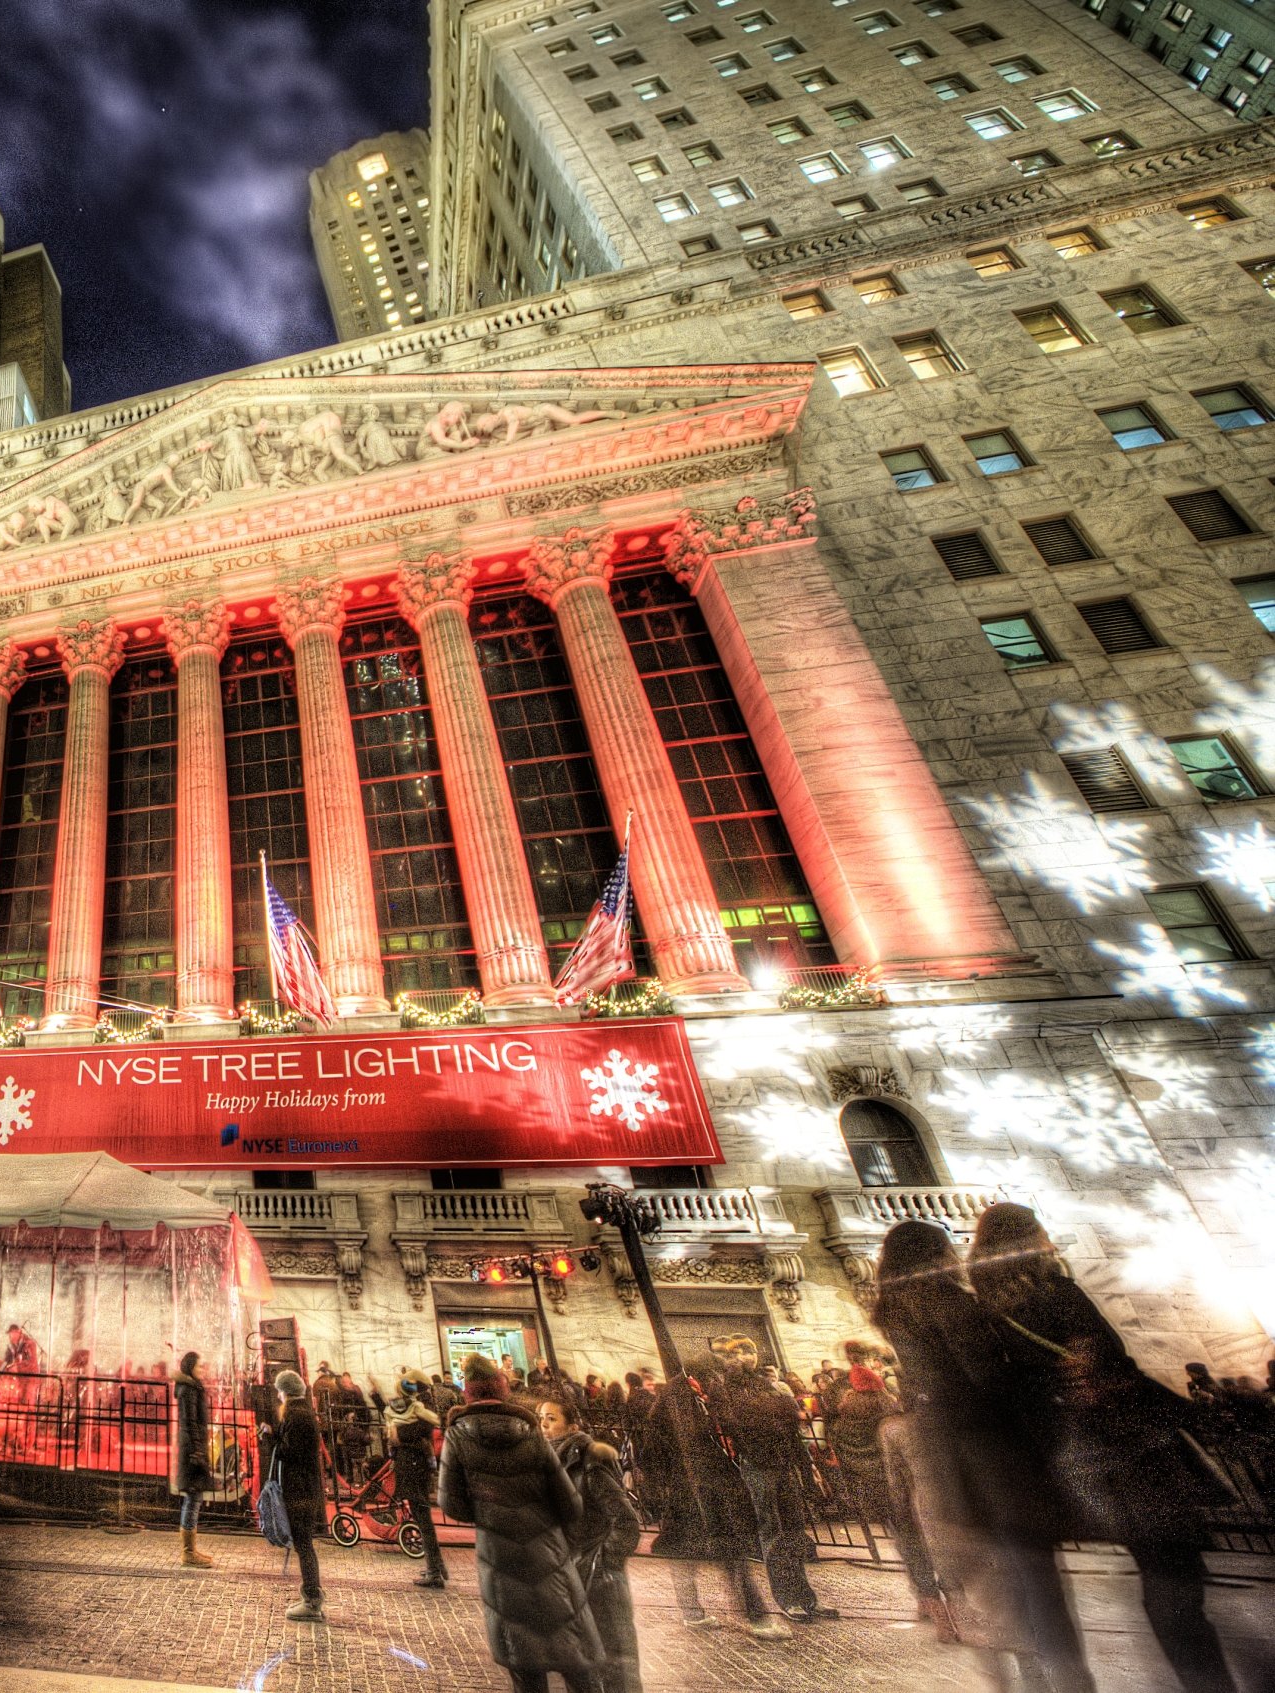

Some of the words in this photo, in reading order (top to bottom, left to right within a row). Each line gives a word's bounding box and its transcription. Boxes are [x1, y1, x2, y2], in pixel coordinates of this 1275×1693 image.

[80, 581, 124, 600] NEW
[138, 565, 199, 588] YORK
[212, 550, 285, 574] STOCK
[299, 518, 435, 558] EXCHANGE
[77, 1056, 182, 1086] NYSE
[192, 1051, 304, 1083] TREE
[316, 1041, 538, 1079] LIGHTING
[205, 1092, 260, 1114] Happy
[263, 1089, 339, 1111] Holidays
[341, 1087, 386, 1111] from
[242, 1138, 284, 1153] NYSE
[288, 1138, 359, 1153] Euronext
